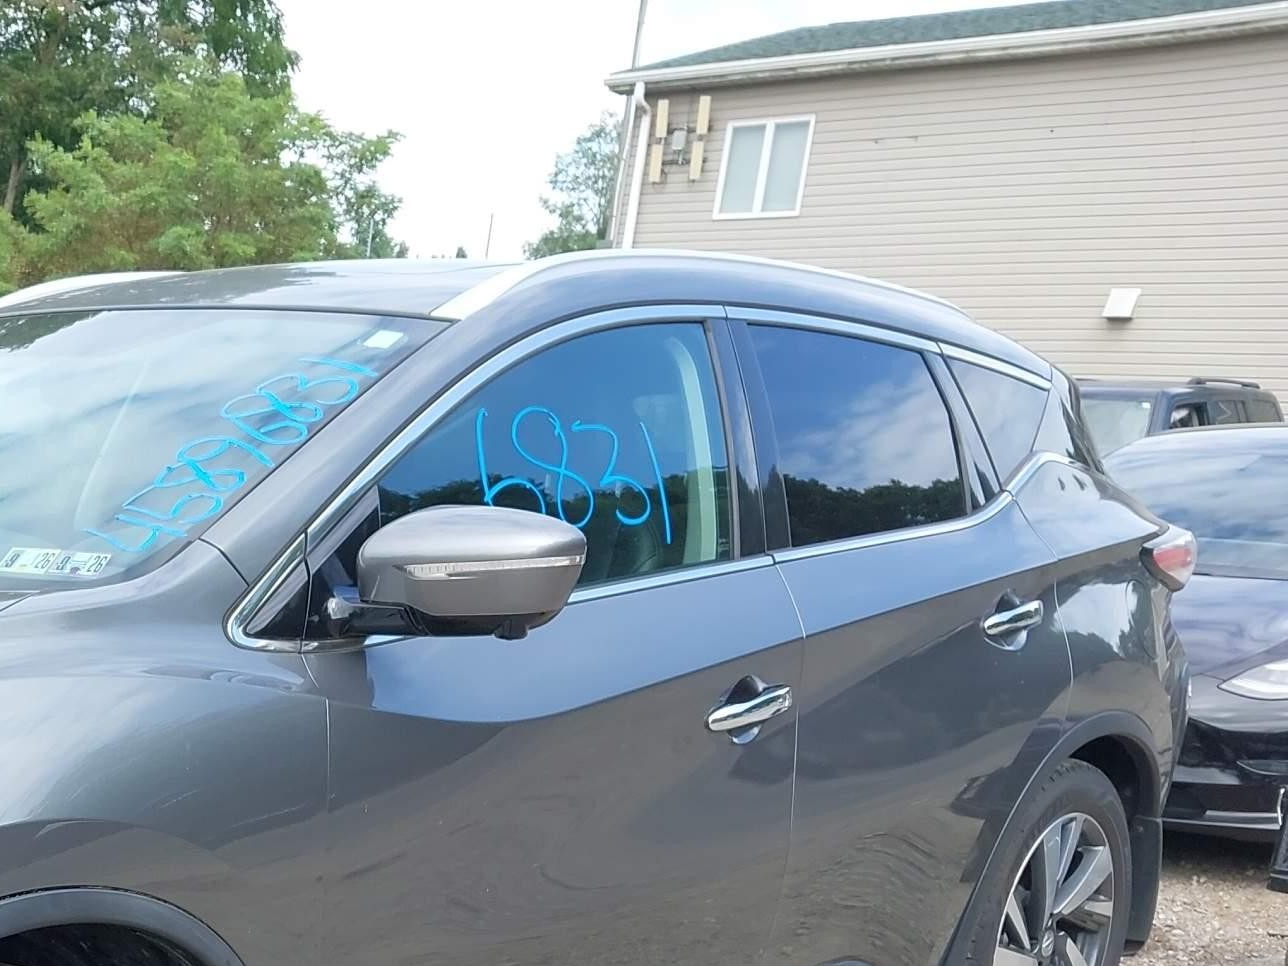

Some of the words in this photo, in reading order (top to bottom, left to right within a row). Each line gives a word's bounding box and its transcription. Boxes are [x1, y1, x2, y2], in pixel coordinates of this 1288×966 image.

[85, 358, 379, 552] 45896831
[476, 406, 672, 545] 6831
[34, 552, 56, 569] 26
[86, 555, 109, 573] 26
